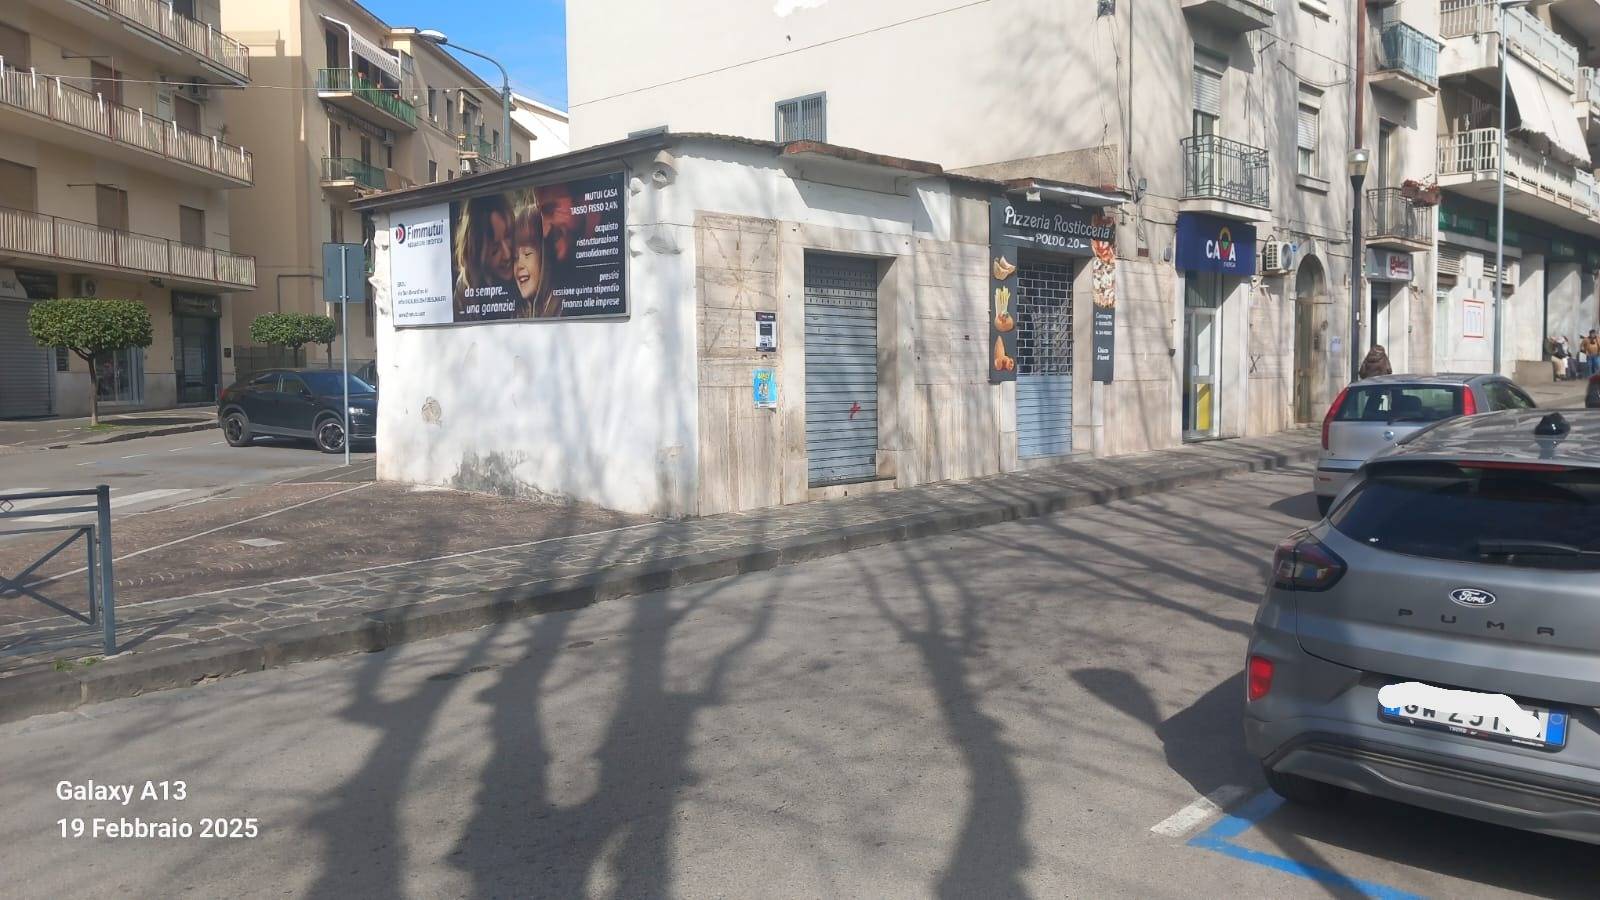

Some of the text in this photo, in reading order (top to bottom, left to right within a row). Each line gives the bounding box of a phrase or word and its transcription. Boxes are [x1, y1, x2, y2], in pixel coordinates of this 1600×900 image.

[585, 188, 618, 201] MUTUI CASA
[570, 204, 587, 215] TASSO
[589, 202, 604, 213] FISSO
[407, 219, 443, 239] Fimmutui
[594, 222, 618, 233] acquisto
[1005, 205, 1110, 239] Pizzeria Rosticceria
[1035, 233, 1066, 247] POLDO
[464, 286, 475, 298] da
[466, 304, 480, 314] una
[482, 300, 515, 316] garanzia!
[1458, 589, 1487, 605] Ford
